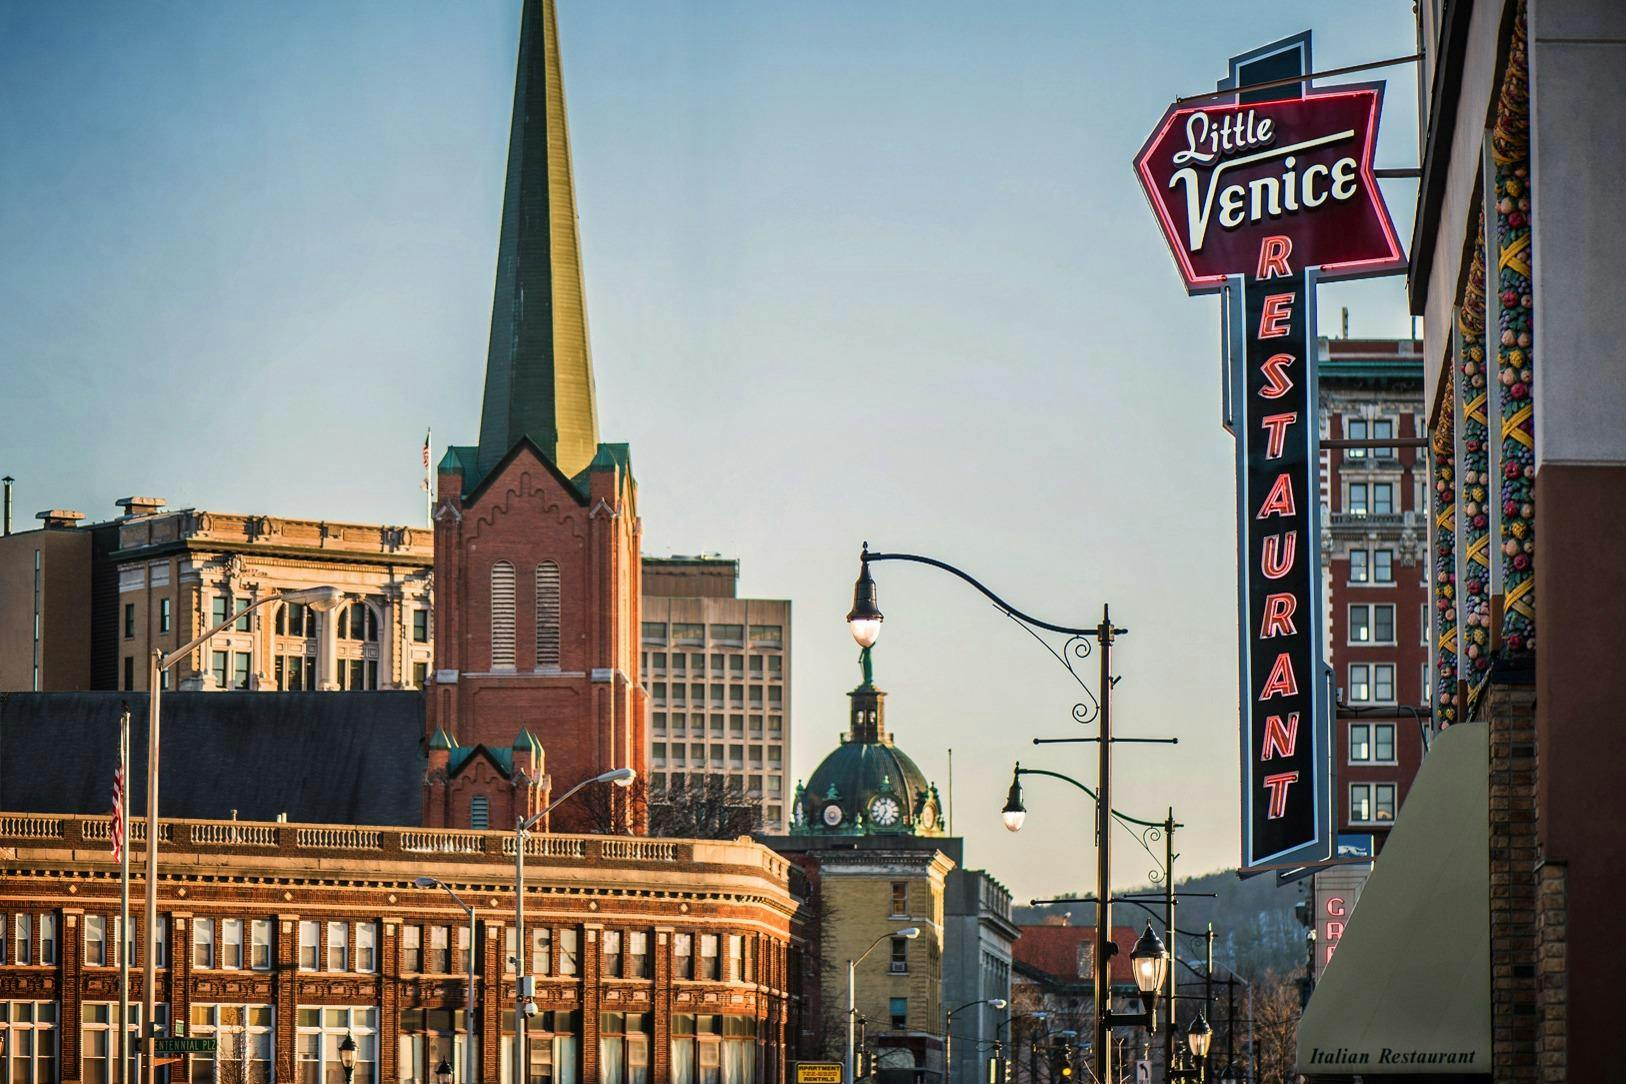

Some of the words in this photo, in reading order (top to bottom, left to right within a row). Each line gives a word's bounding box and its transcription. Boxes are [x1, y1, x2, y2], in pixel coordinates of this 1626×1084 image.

[1172, 109, 1273, 163] Little
[1168, 154, 1357, 251] Venice
[1256, 235, 1300, 821] RESTAURANT
[154, 1039, 199, 1051] ENTENNIAL
[202, 1039, 216, 1051] PLZ
[1310, 1047, 1369, 1065] Italian
[1378, 1047, 1476, 1065] Restaurant
